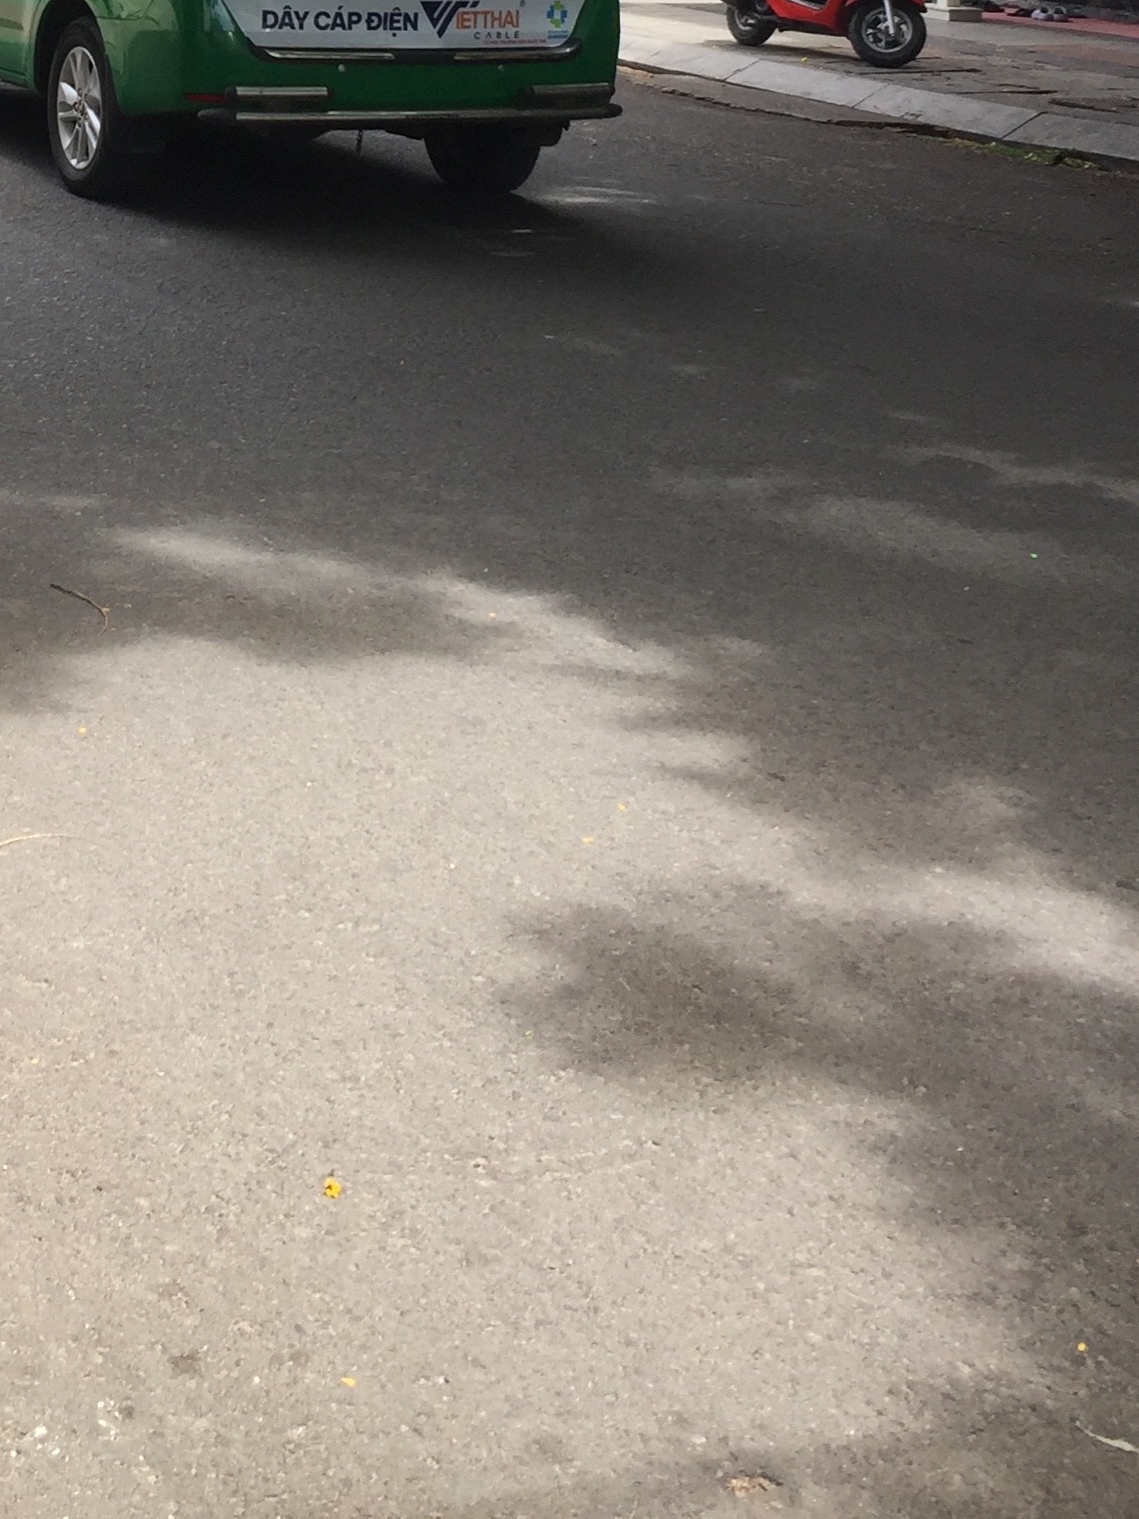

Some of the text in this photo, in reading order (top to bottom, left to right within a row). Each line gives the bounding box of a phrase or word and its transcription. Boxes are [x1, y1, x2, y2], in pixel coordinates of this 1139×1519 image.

[261, 5, 310, 30] DÂY
[314, 5, 361, 30] CÁP
[364, 6, 419, 38] ĐIỆN
[473, 31, 520, 40] CABLE
